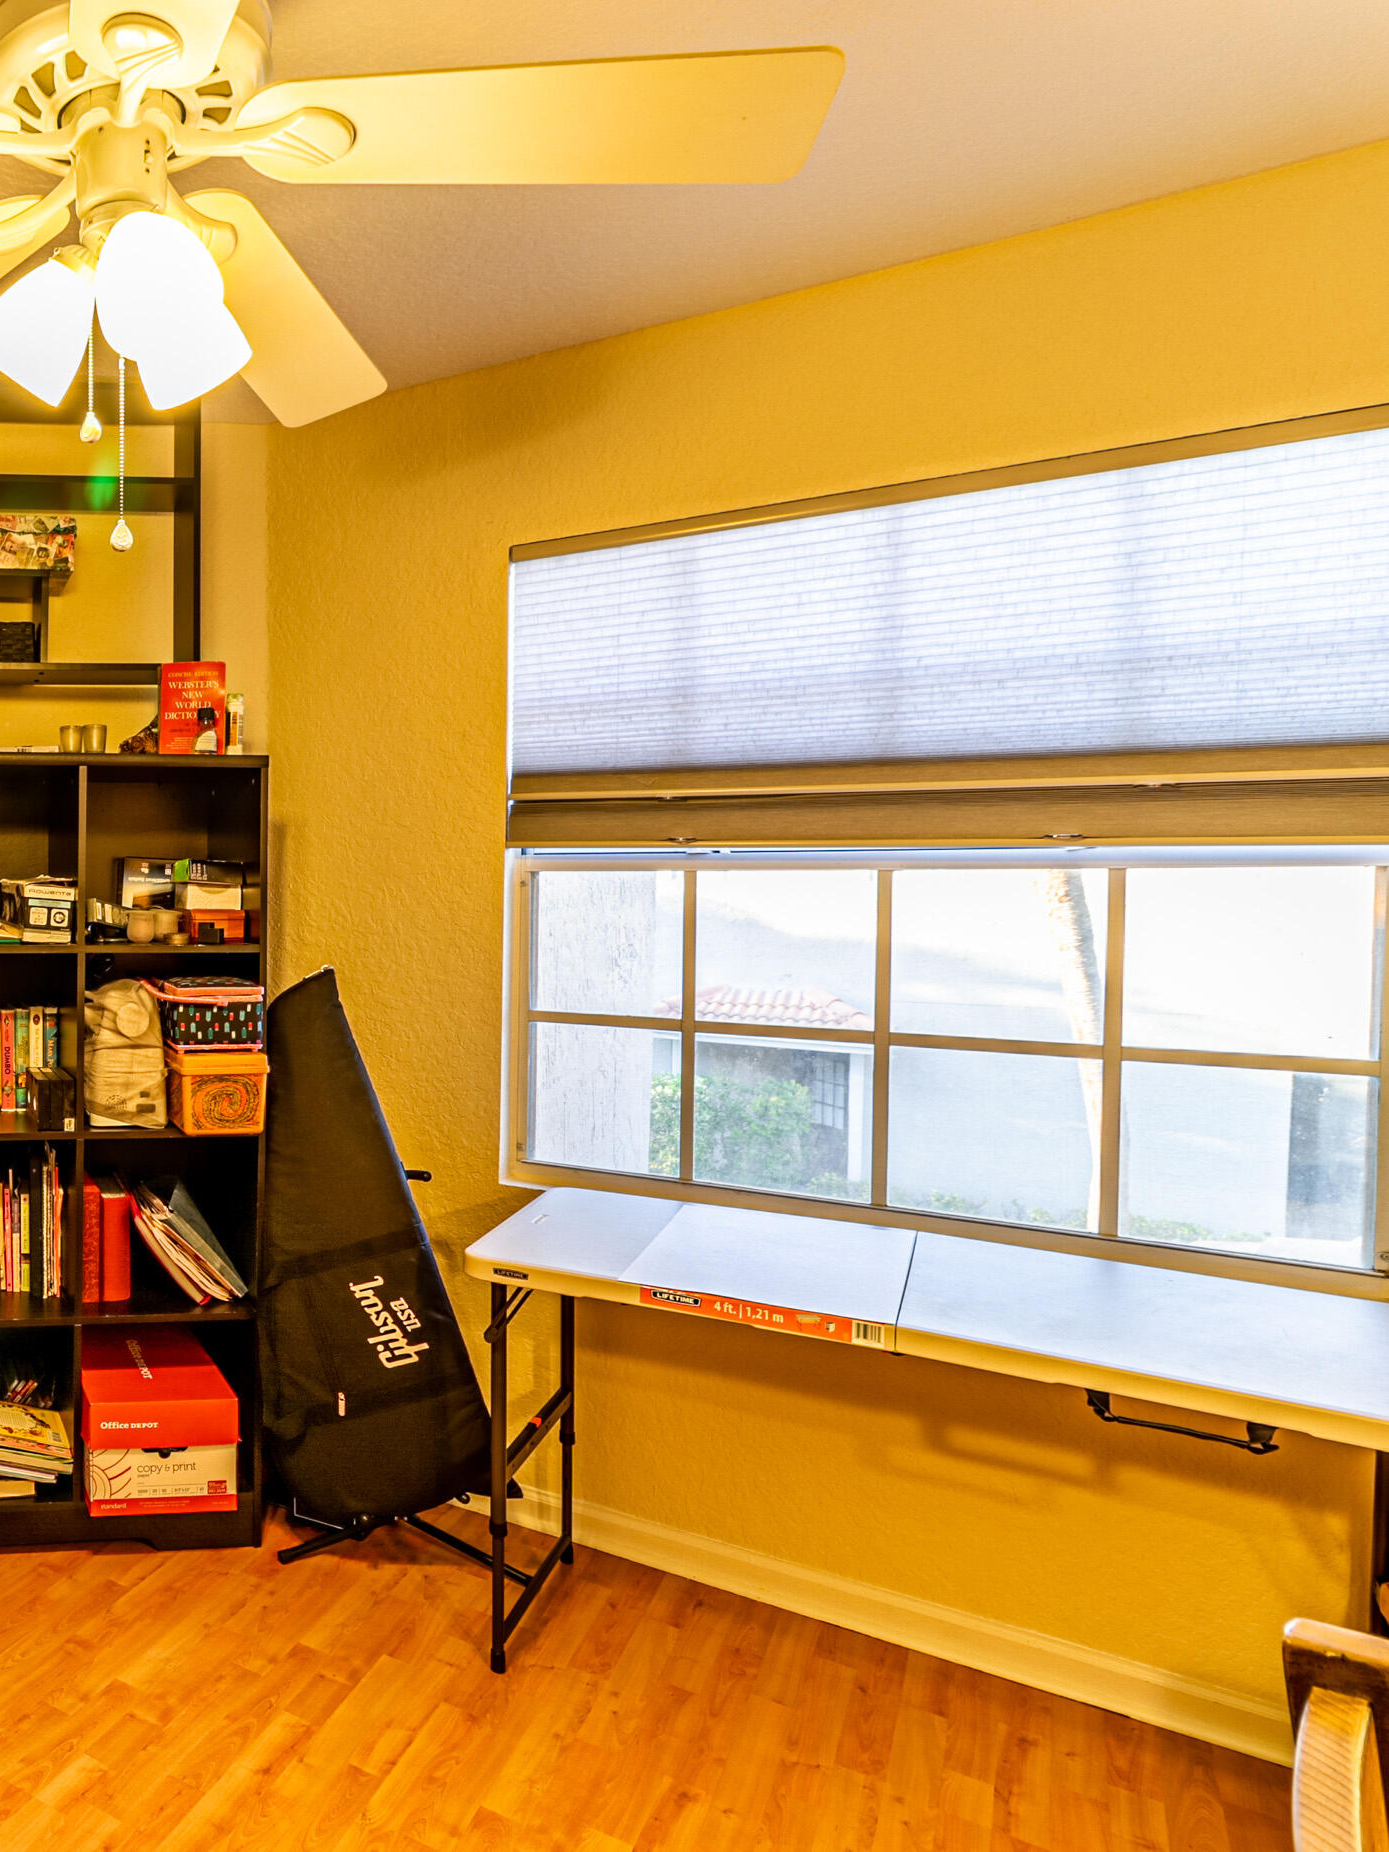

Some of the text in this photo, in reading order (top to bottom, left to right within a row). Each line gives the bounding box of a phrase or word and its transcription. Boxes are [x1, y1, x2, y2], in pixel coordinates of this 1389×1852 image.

[168, 680, 220, 689] WEBSTER'S
[182, 691, 203, 699] NEW
[175, 701, 211, 709] WORLD
[164, 710, 222, 720] DICTIOY
[497, 1270, 525, 1279] LIFETIME
[656, 1292, 695, 1305] LIFETIME
[714, 1302, 784, 1323] 4 ft. 1,21 m
[349, 1275, 429, 1368] Gibson
[100, 1421, 158, 1430] Office DEPOT
[136, 1462, 163, 1475] copy
[172, 1462, 196, 1474] print
